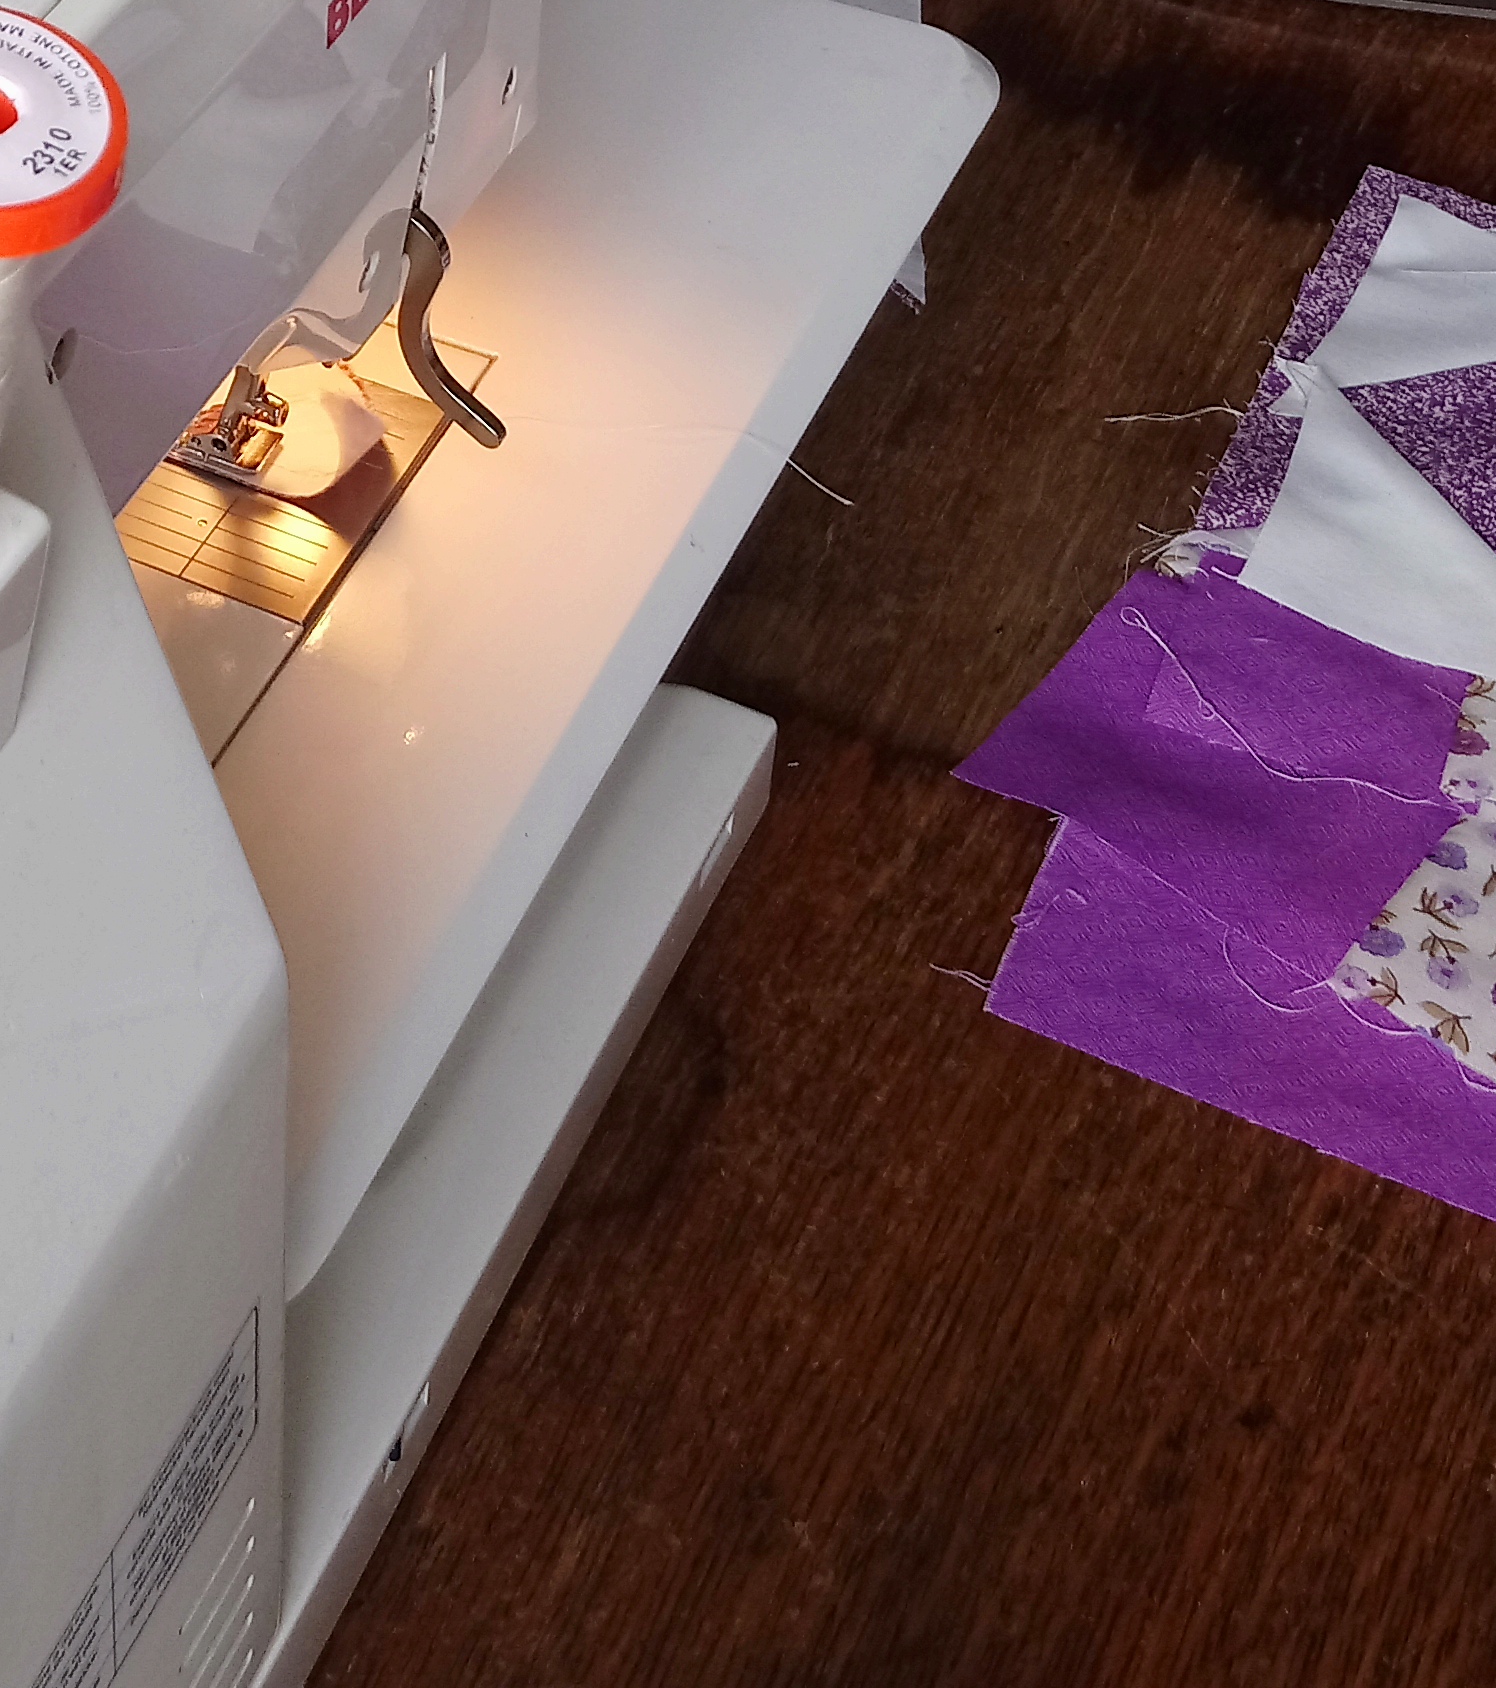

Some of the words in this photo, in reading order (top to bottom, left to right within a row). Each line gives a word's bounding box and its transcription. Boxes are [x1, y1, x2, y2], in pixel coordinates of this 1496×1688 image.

[31, 31, 90, 79] COTONE
[33, 55, 54, 71] IN
[54, 71, 82, 108] MADE
[84, 80, 103, 114] 100%
[22, 126, 73, 175] 2310
[53, 147, 88, 178] 1ER
